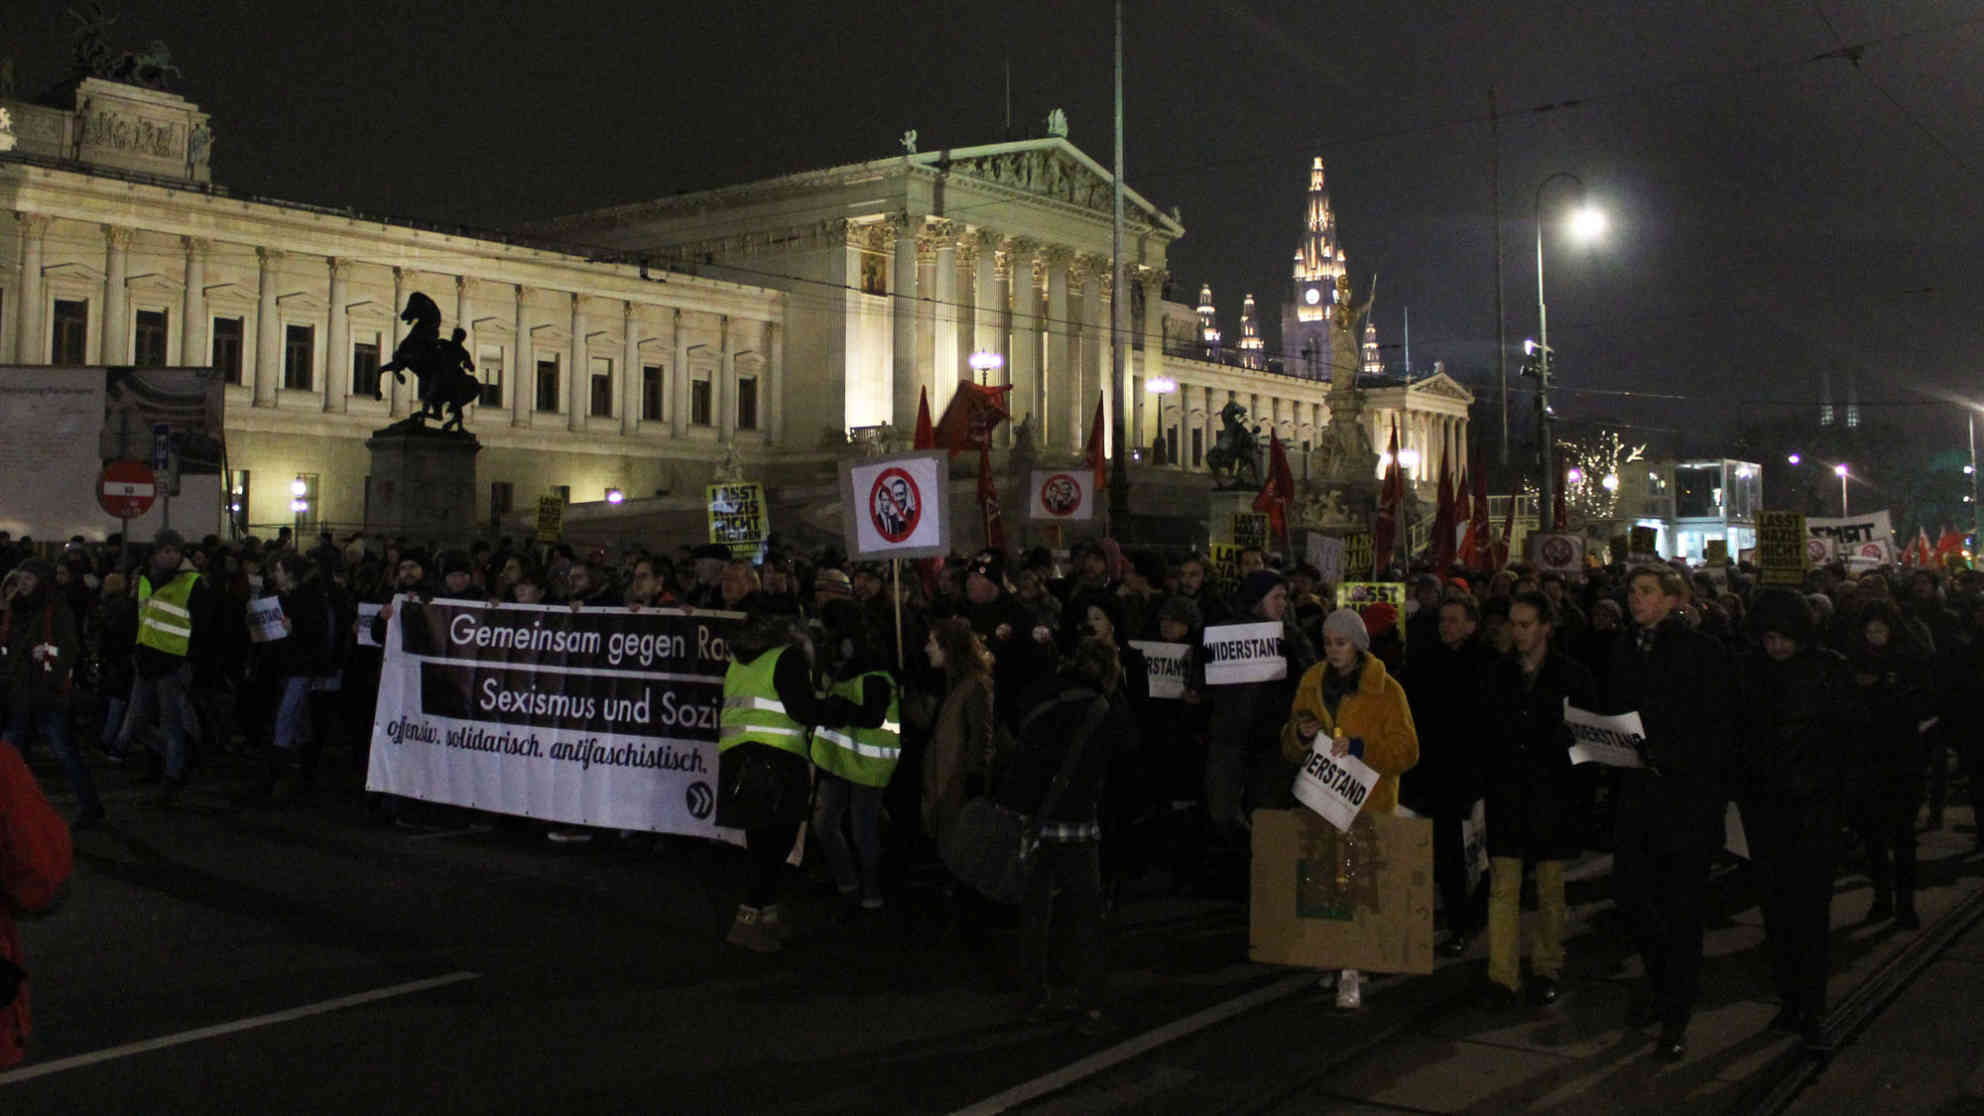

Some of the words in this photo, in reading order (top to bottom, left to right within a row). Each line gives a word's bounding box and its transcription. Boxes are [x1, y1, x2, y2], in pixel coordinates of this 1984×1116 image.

[1342, 586, 1398, 600] LSST
[450, 613, 600, 654] Gemeinsam
[607, 631, 686, 666] gegen
[480, 677, 597, 720] Sexismus
[603, 687, 650, 724] und
[661, 690, 718, 729] Sozi
[447, 726, 544, 758] solidarisch.
[549, 736, 708, 775] antifaschistisch.
